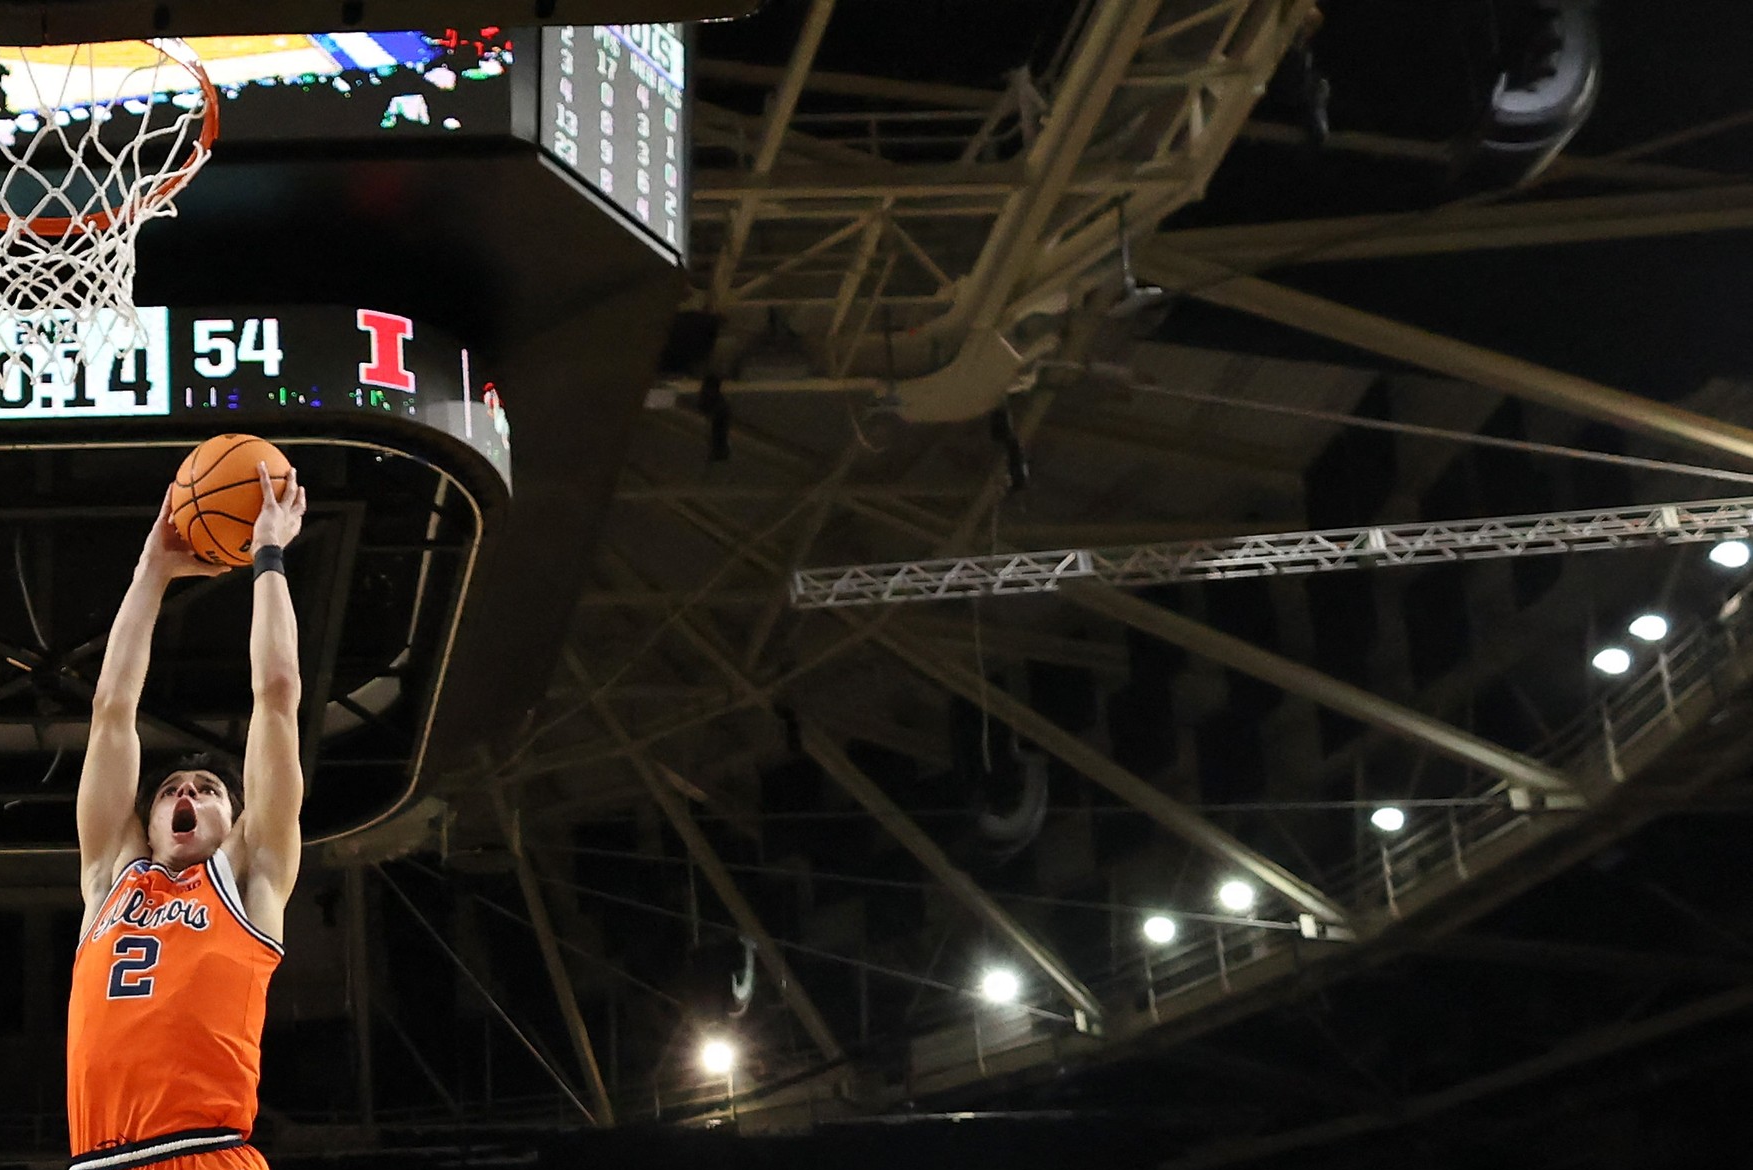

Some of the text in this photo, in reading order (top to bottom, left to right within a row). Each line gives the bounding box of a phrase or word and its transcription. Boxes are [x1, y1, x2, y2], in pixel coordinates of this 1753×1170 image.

[666, 135, 676, 161] 1
[666, 219, 677, 244] 1
[193, 317, 284, 379] 54
[106, 934, 162, 1001] 2
